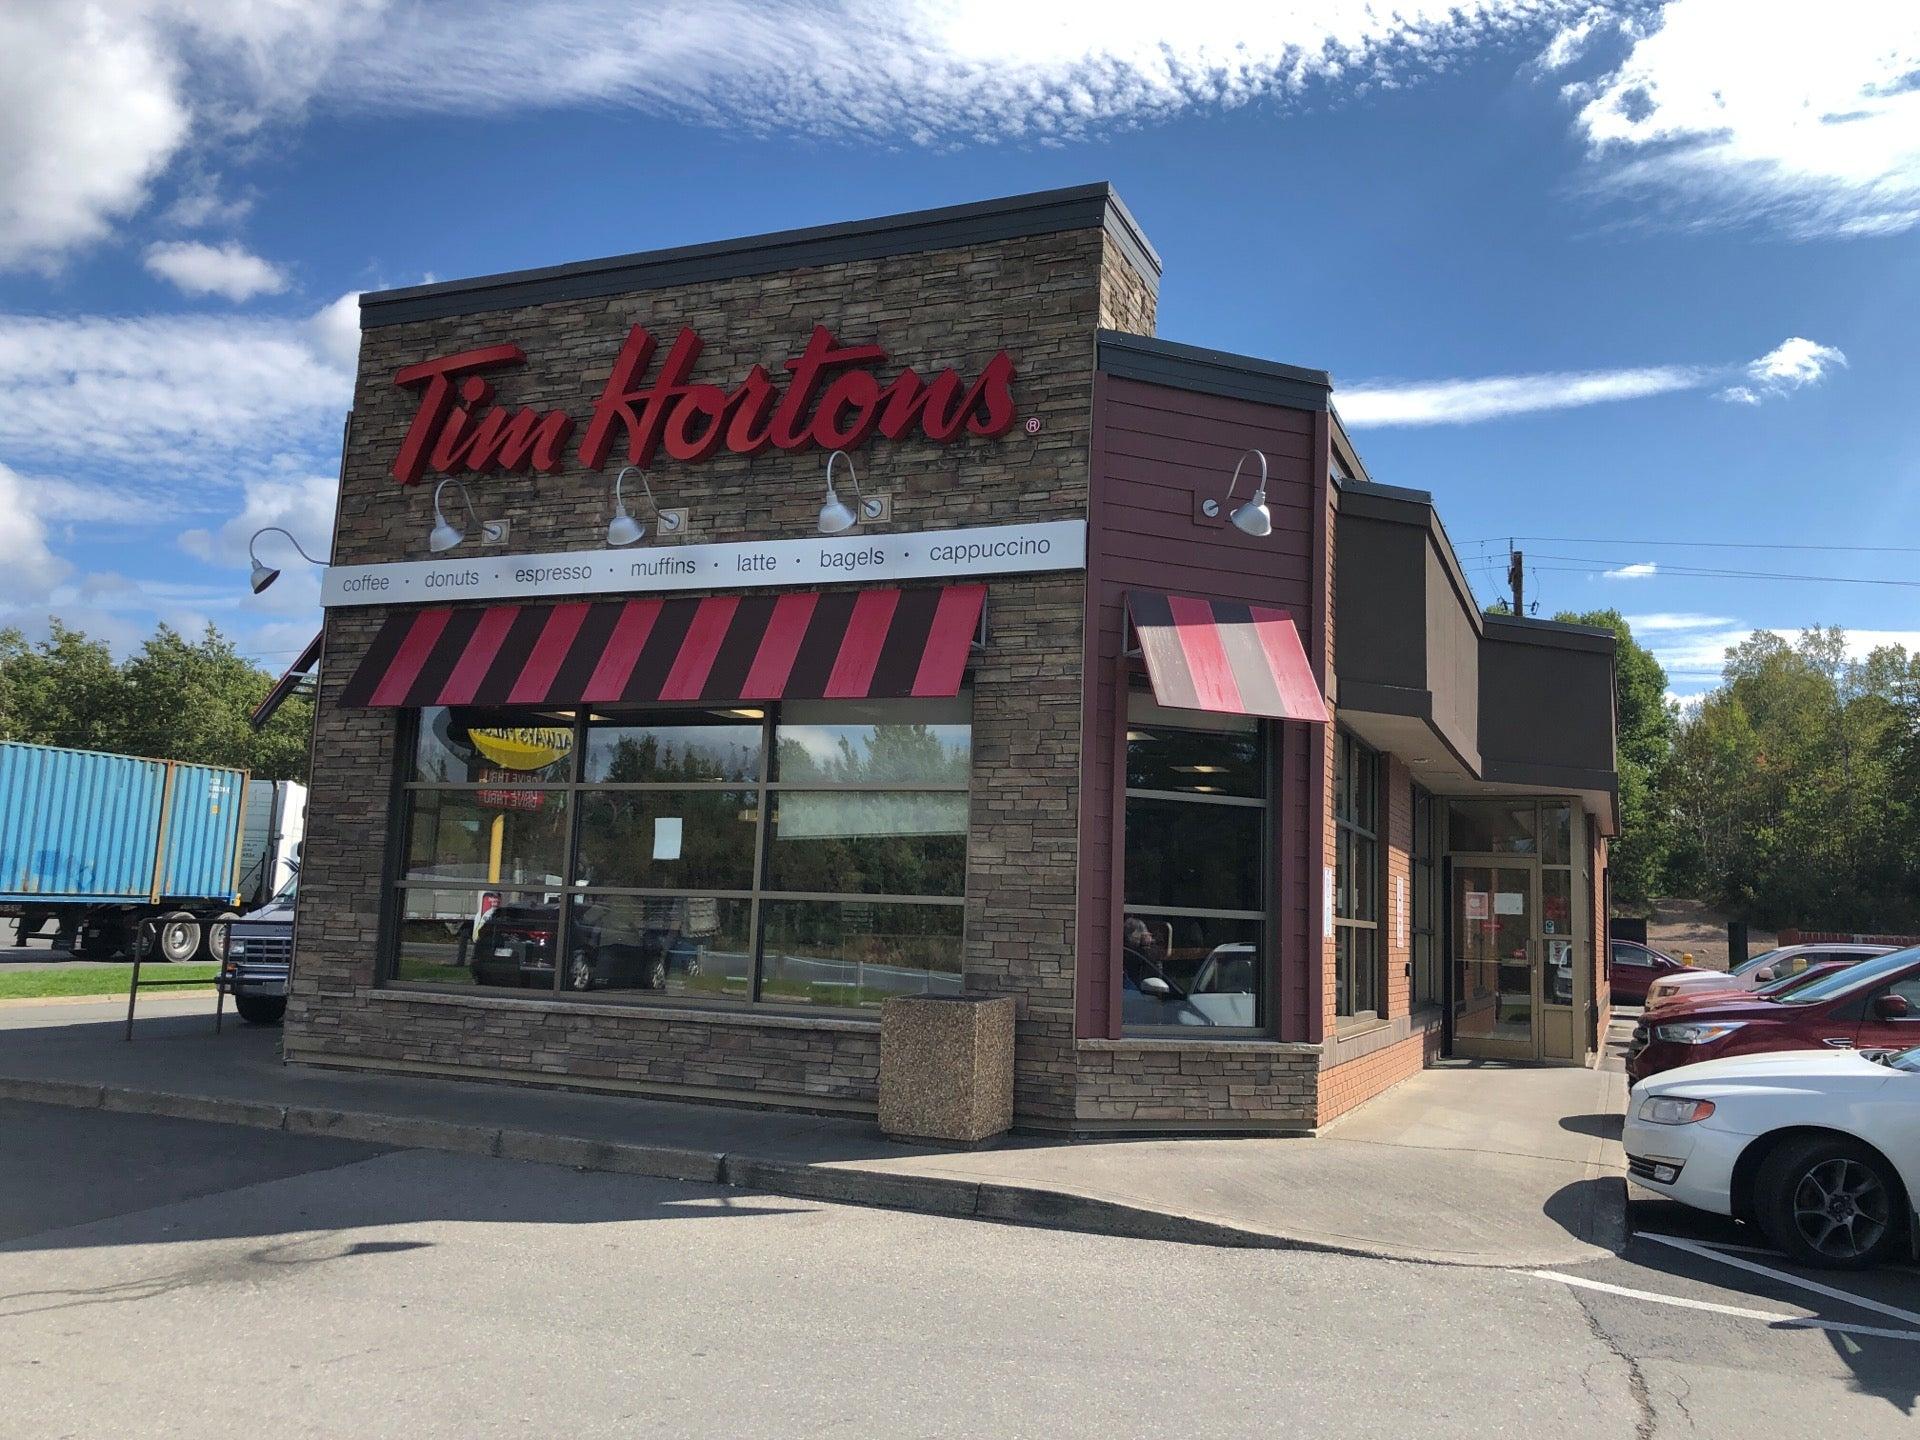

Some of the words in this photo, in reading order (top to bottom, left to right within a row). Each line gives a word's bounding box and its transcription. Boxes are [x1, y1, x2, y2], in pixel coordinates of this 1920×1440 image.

[392, 343, 575, 486] Tim
[578, 322, 1017, 472] Hortons
[342, 575, 390, 593] coffee
[424, 570, 480, 589] donuts
[514, 564, 593, 586] espresso
[630, 557, 696, 578] muffins
[736, 553, 777, 572] latte
[820, 546, 885, 571] bagels
[929, 536, 1051, 563] cappuccino
